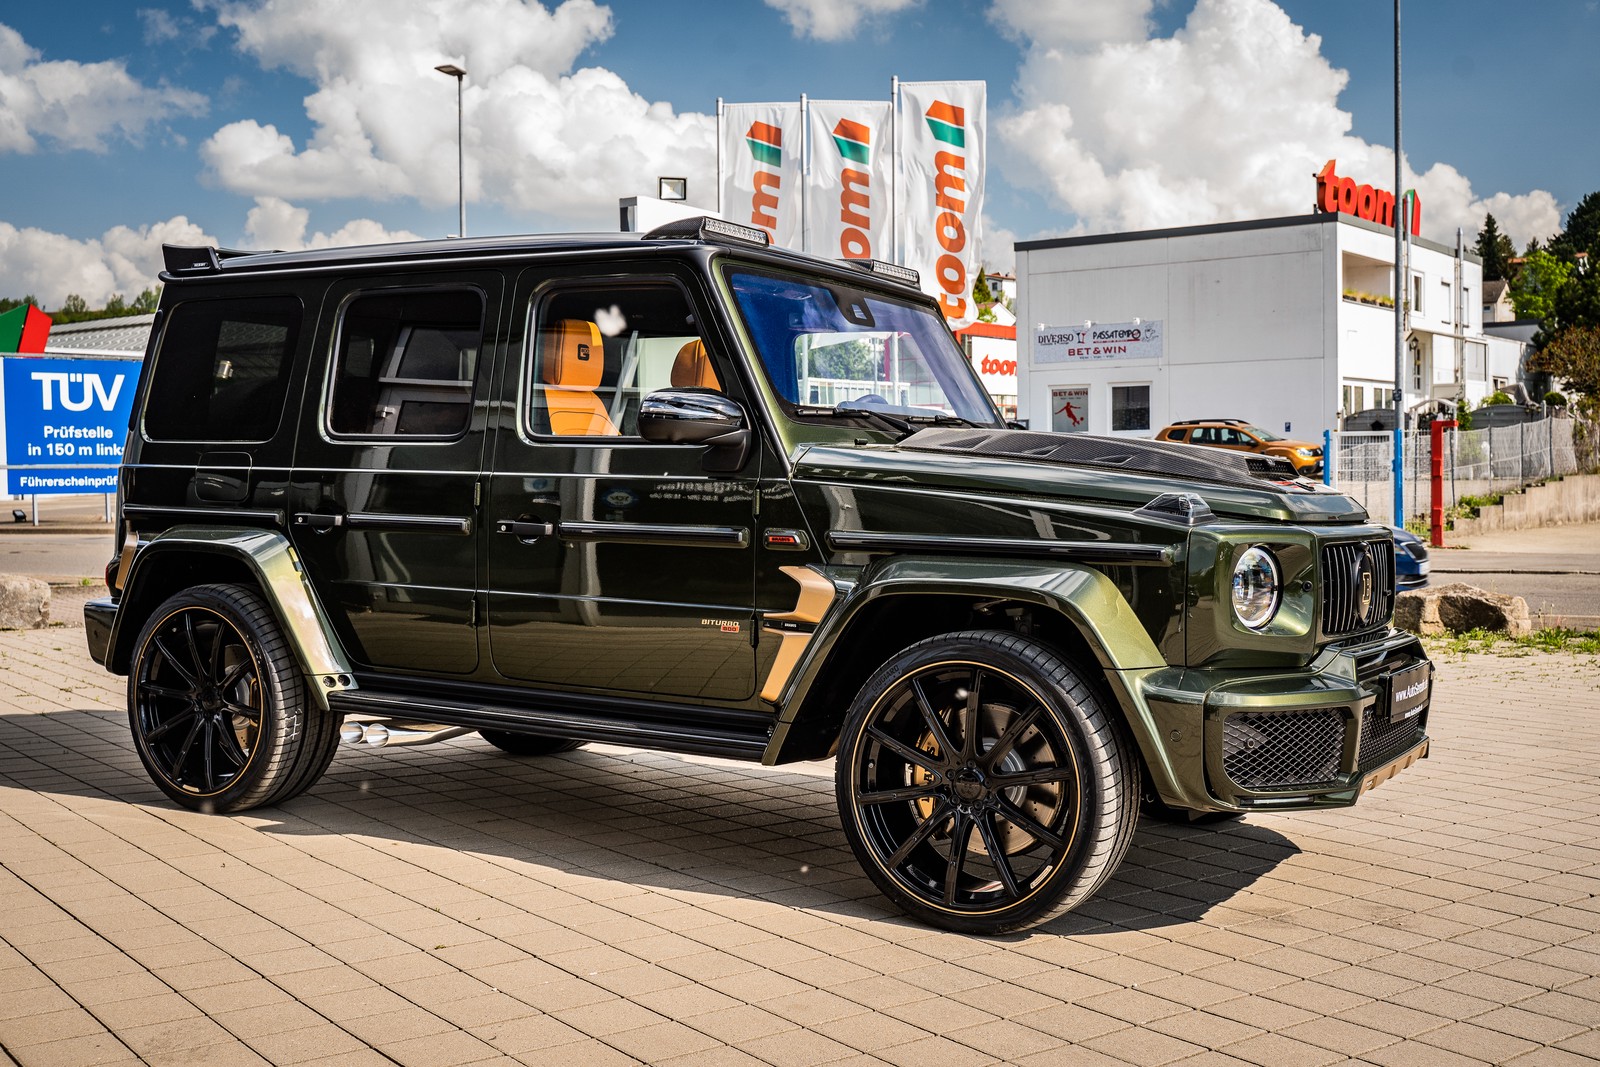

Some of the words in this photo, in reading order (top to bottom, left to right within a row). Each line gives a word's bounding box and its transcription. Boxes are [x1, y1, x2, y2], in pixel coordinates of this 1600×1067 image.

[934, 150, 967, 320] toom
[1093, 328, 1141, 340] PASSATEMPO
[31, 372, 125, 412] TÜV
[43, 425, 113, 439] Prüfstelle
[28, 443, 42, 456] in
[46, 443, 75, 456] 150
[78, 446, 92, 456] m
[20, 475, 118, 488] Führerscheinprüf
[701, 619, 739, 627] BITURBO
